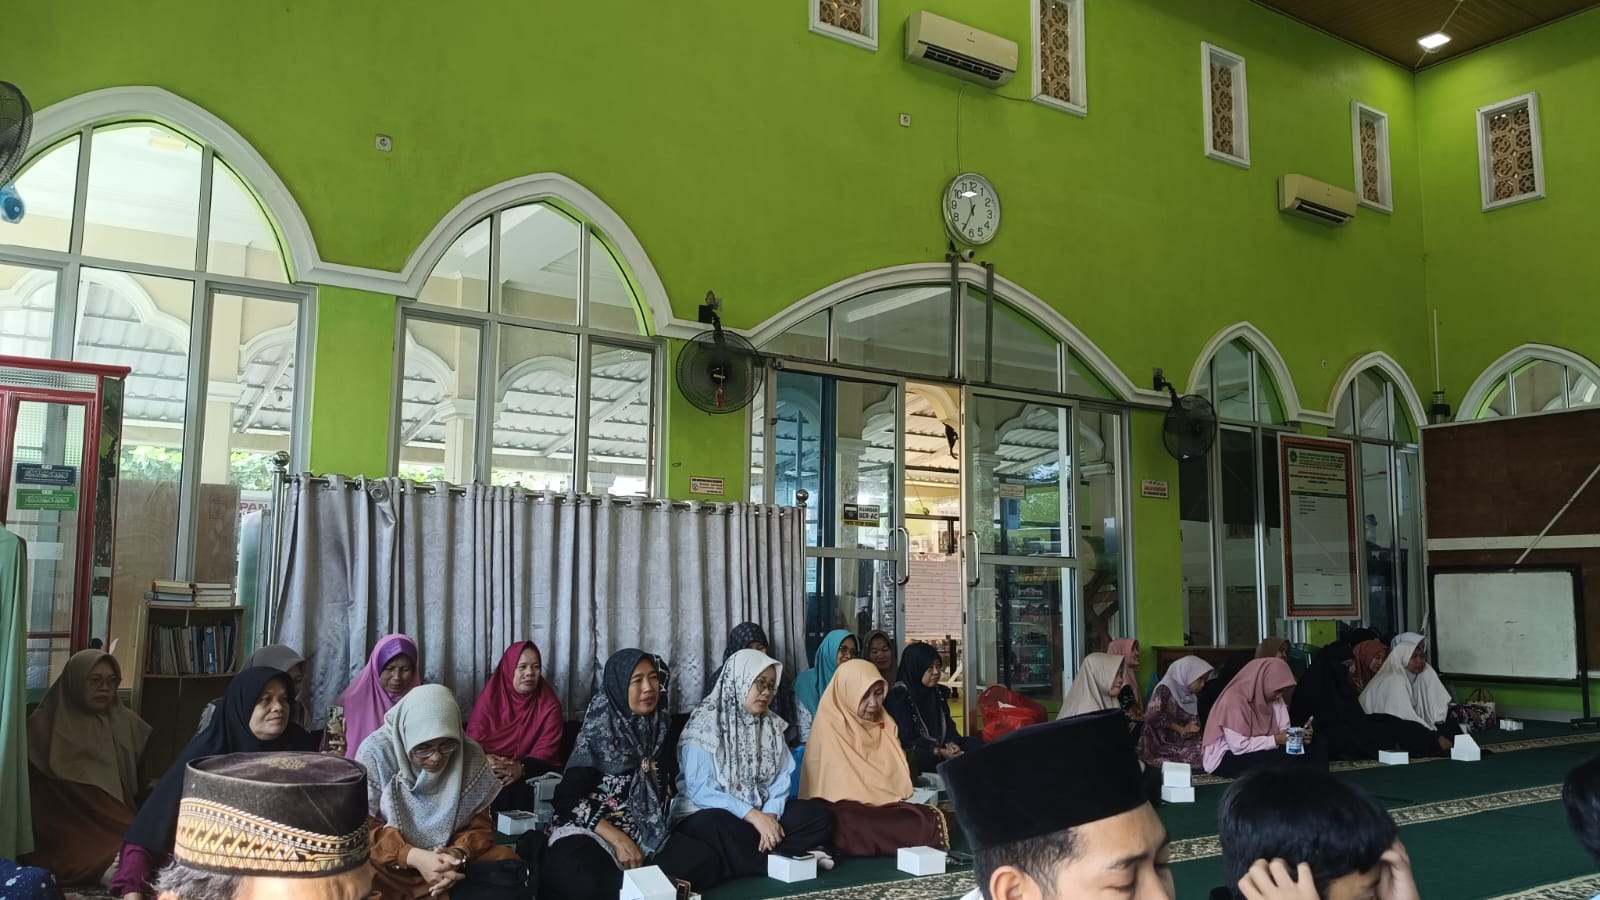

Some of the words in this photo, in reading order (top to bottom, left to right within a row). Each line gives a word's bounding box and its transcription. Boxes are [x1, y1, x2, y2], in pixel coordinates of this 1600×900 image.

[962, 182, 968, 192] 11
[954, 188, 962, 199] 10
[952, 200, 957, 210] 9
[984, 198, 991, 208] 2
[953, 212, 959, 222] 8
[986, 210, 992, 219] 3
[961, 222, 967, 232] 7
[984, 220, 990, 229] 4
[968, 228, 974, 238] 6
[977, 227, 983, 237] 5
